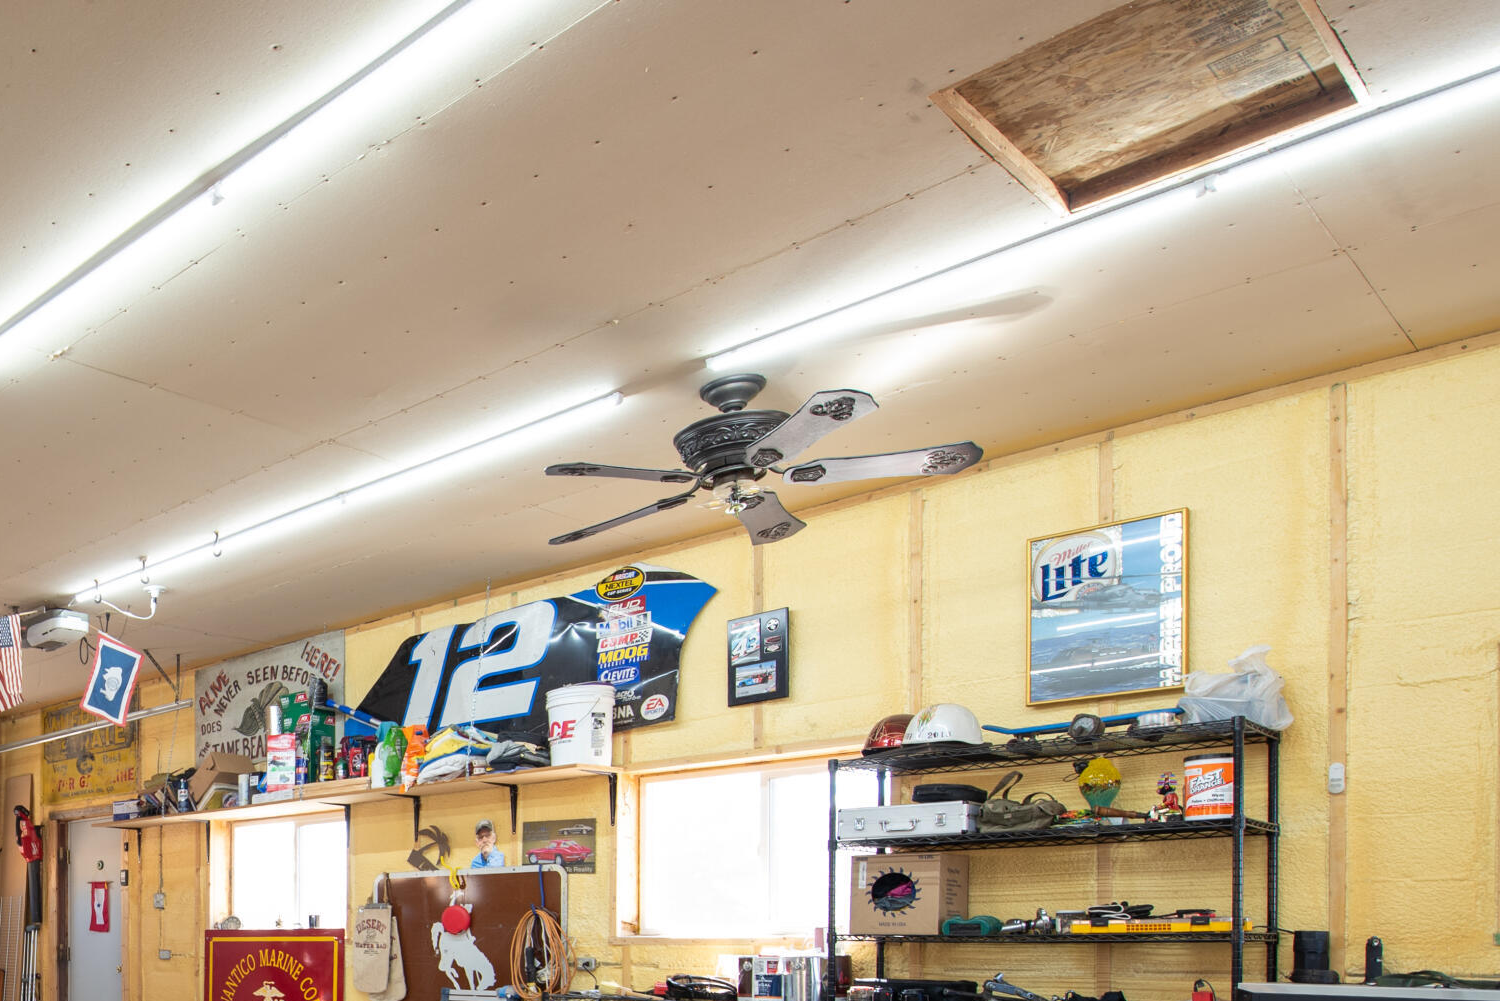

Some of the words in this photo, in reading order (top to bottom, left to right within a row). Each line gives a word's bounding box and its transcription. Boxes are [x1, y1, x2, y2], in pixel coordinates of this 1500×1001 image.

[604, 580, 635, 591] NEXTEL
[1040, 550, 1109, 602] Lite
[601, 632, 639, 649] COMP
[598, 644, 649, 664] MOOG
[402, 600, 559, 731] 12
[601, 667, 636, 682] CLEVITE
[198, 669, 231, 717] ALIVE
[300, 641, 342, 683] HERE!
[214, 679, 242, 718] NEVER
[246, 665, 279, 686] SEEN
[645, 698, 665, 711] EA
[201, 720, 222, 736] DOES
[1190, 768, 1225, 788] FAST
[355, 918, 387, 935] DESERT
[259, 948, 305, 981] MARINE
